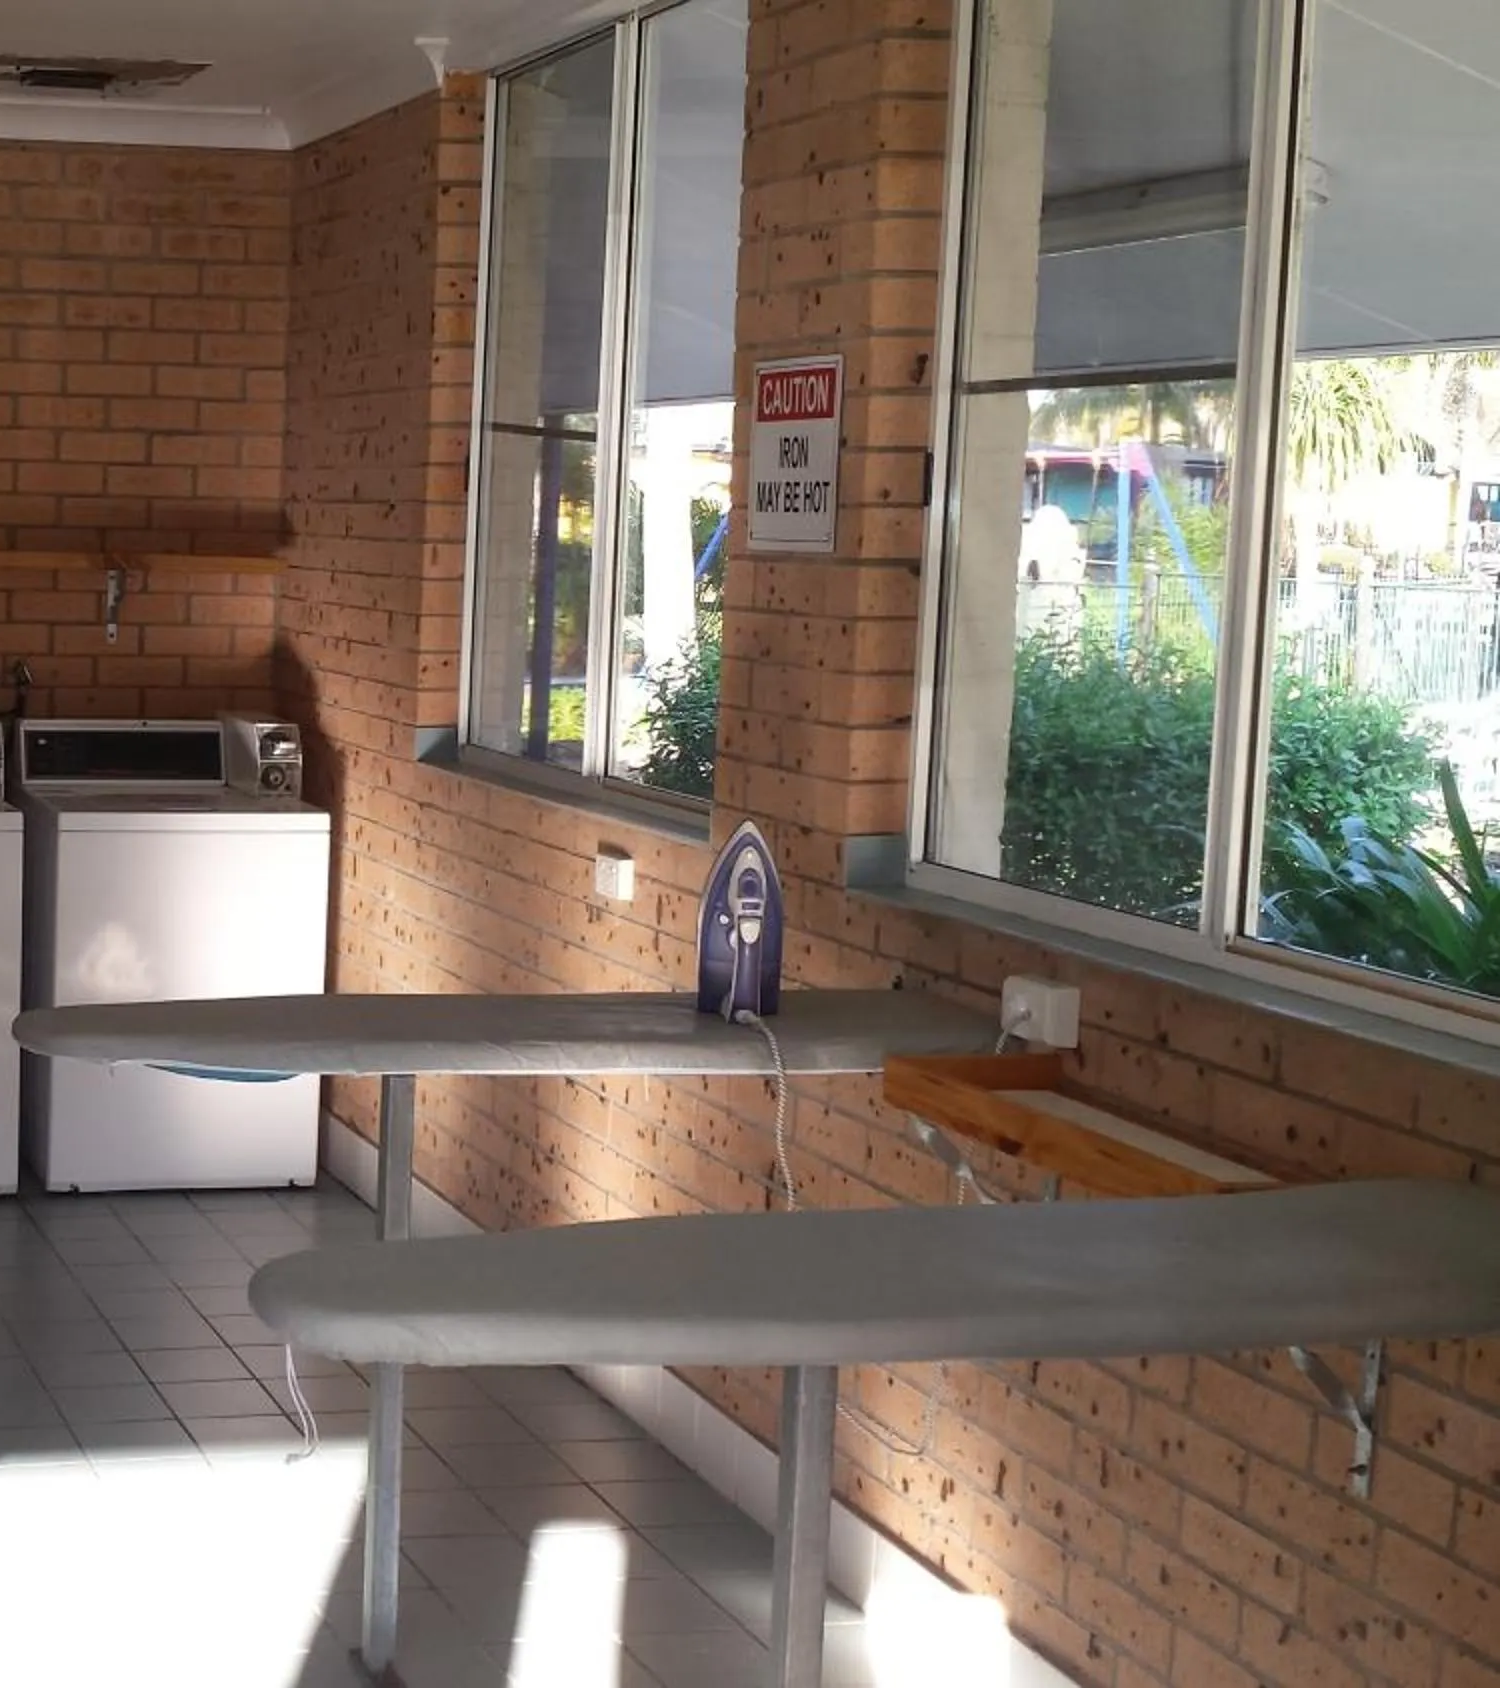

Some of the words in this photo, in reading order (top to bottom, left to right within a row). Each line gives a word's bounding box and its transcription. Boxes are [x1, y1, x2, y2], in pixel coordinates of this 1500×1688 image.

[762, 375, 829, 415] CAUTION
[778, 435, 809, 469] IRON
[756, 480, 782, 513] MAY
[783, 481, 800, 513] BE
[802, 480, 830, 513] HOT
